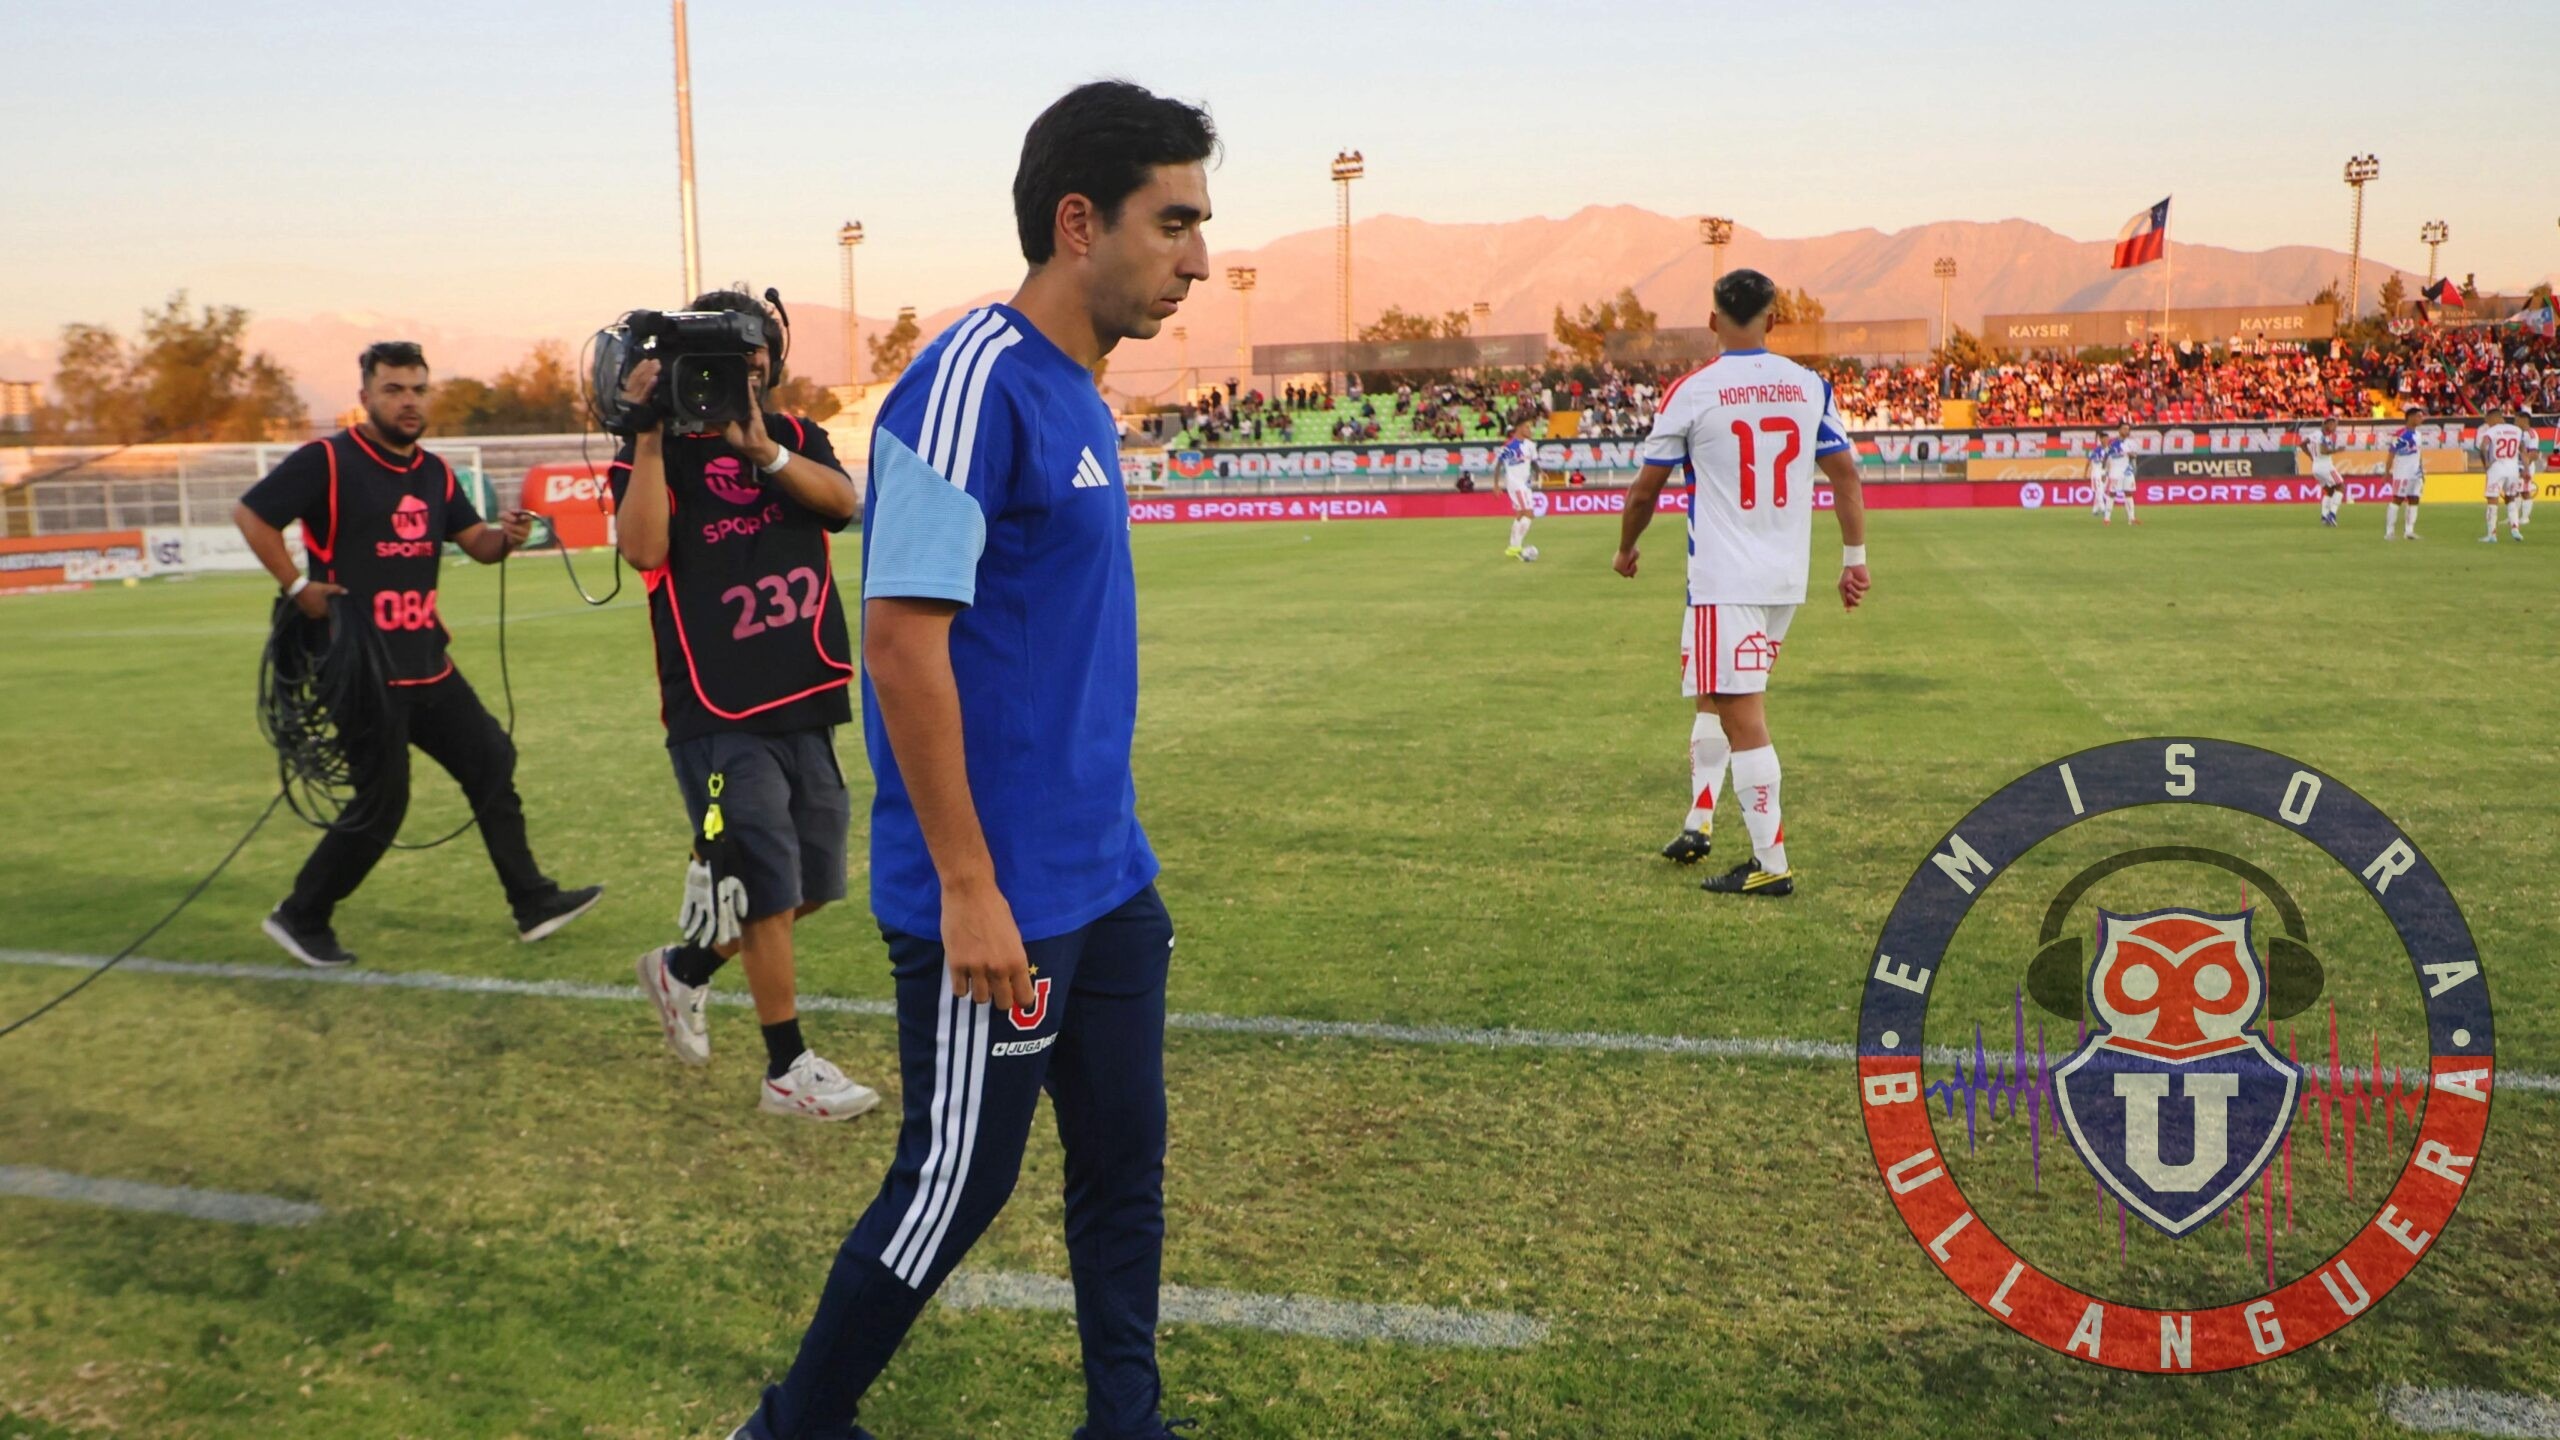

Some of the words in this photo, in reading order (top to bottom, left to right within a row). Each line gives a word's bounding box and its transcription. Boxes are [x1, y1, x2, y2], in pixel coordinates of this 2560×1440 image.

[2008, 324, 2069, 339] KAYSER
[2240, 316, 2304, 330] KAYSER
[1718, 380, 1808, 406] HORMAZÁBAL
[1212, 450, 1357, 478] SOMOS
[1366, 447, 1448, 475] LOS
[1874, 433, 1970, 464] VOZ
[1982, 431, 2048, 460] DE
[2060, 428, 2195, 457] TDO
[2208, 425, 2286, 453] UN
[2496, 438, 2518, 458] 20
[1731, 416, 1800, 510] 17
[2173, 459, 2252, 478] POWER
[2147, 484, 2267, 502] SPORTS
[2273, 484, 2292, 500] &
[2300, 482, 2394, 500] MDIA
[1187, 501, 1285, 518] SPORTS
[1288, 502, 1304, 517] &
[1309, 499, 1388, 516] MEDIA
[1555, 494, 1626, 512] LIONS
[703, 503, 784, 544] SPORTS
[720, 566, 820, 640] 232
